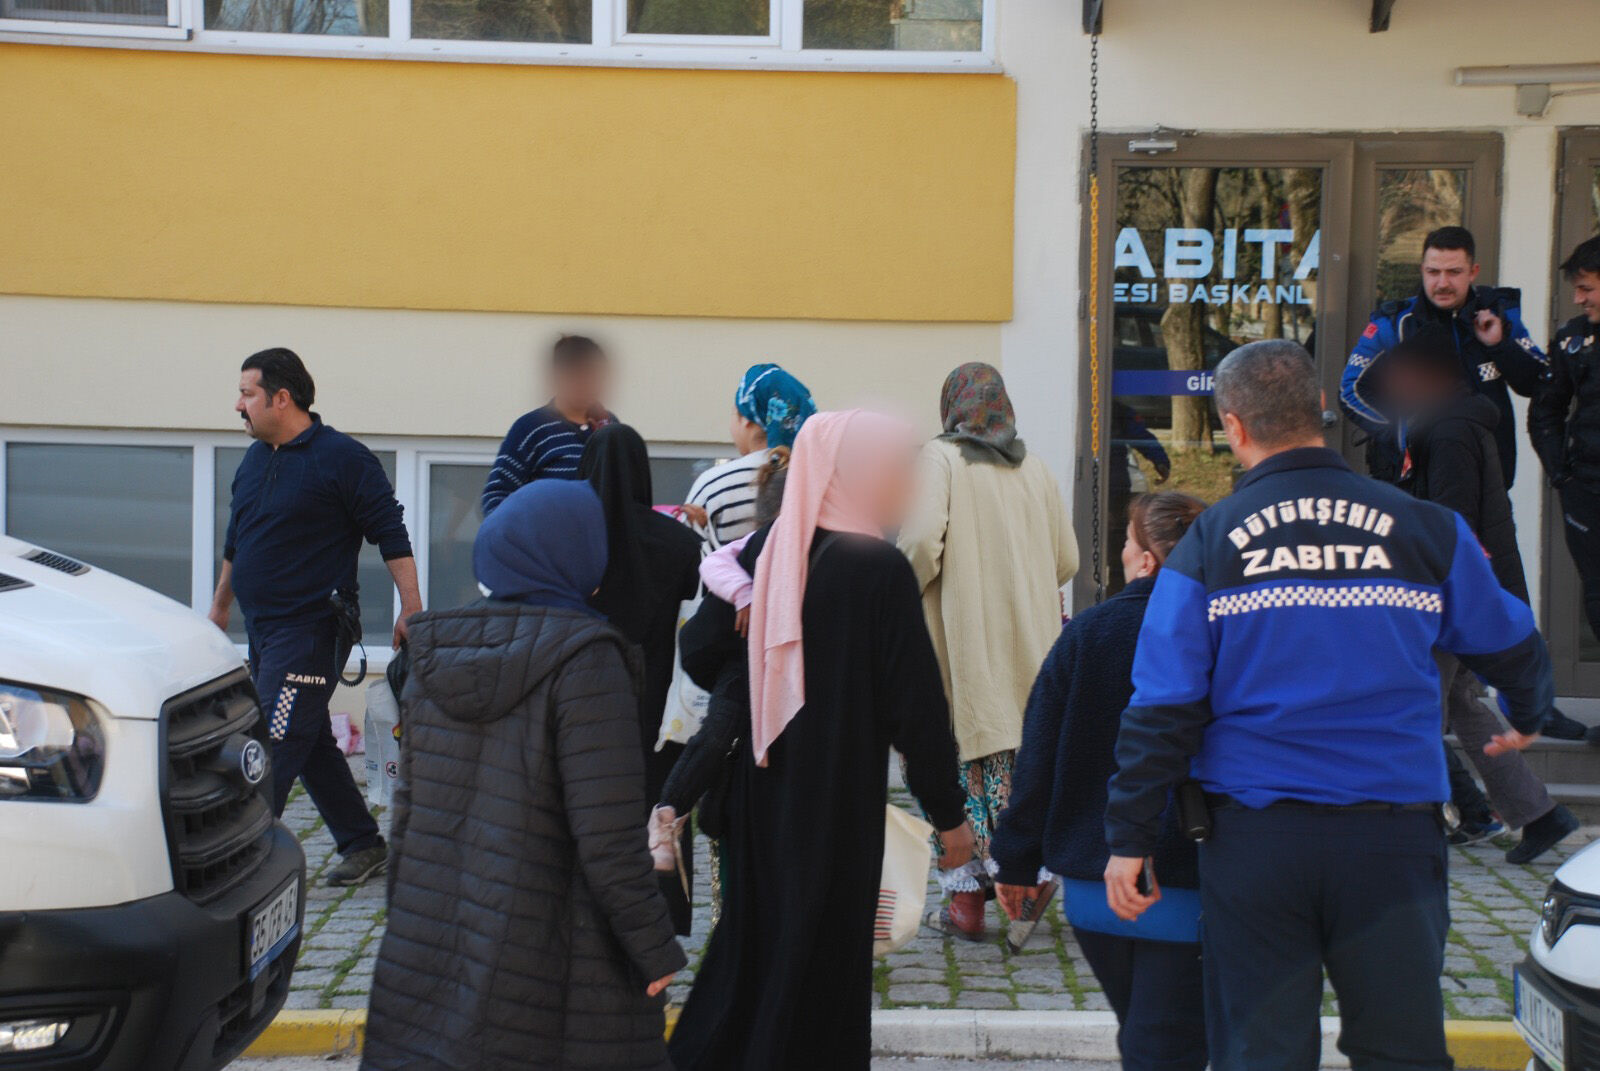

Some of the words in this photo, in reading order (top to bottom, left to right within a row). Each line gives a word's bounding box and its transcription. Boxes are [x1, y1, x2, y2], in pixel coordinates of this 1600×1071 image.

[1169, 283, 1313, 307] BAŞKANL
[1228, 498, 1394, 550] BÜYÜKŞEHİR
[1241, 544, 1392, 577] ZABITA
[286, 672, 326, 685] ZABITA
